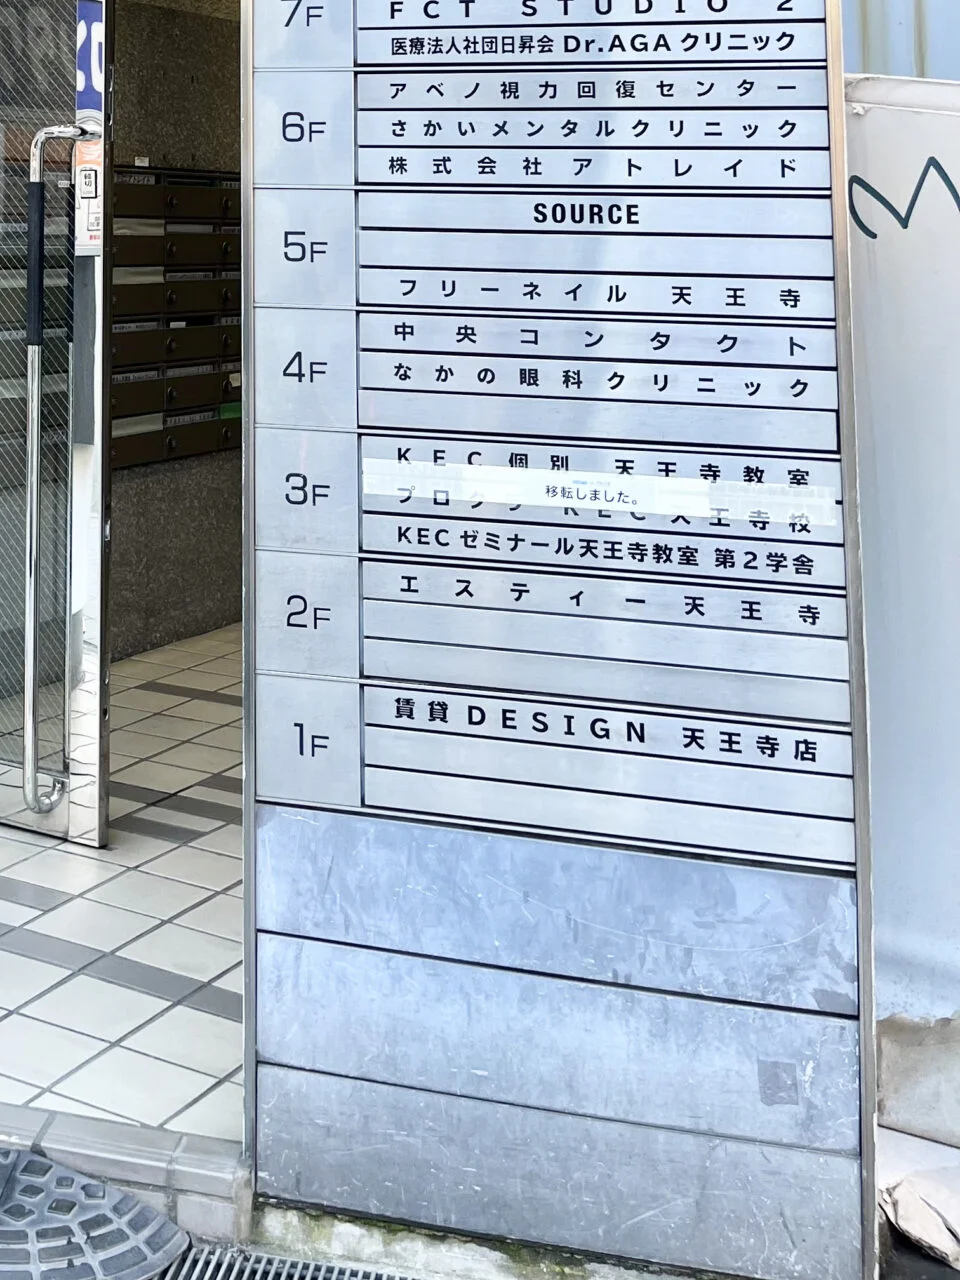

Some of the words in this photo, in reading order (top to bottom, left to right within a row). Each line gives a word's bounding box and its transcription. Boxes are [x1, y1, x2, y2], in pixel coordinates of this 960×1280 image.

[390, 35, 554, 57] 医療法人社団日昇会
[389, 79, 798, 101] アベノ視力回復センター
[282, 111, 326, 144] 6F
[390, 118, 798, 140] さかいメンタルクリニック
[388, 156, 798, 179] 株式会社アトレイド
[533, 203, 640, 225] SOURCE
[283, 230, 328, 263] 5F
[400, 279, 628, 304] フリーネイル
[671, 285, 802, 309] 天王寺
[394, 322, 808, 357] 中央コンタクト
[283, 352, 328, 384] 4F
[393, 363, 810, 400] なかの眼科クリニック
[285, 472, 330, 507] 3F
[544, 483, 639, 507] 移転しました。
[713, 547, 816, 577] 第2学舎
[286, 594, 332, 630] 2F
[400, 575, 822, 627] エスティー天王寺
[294, 723, 330, 758] 1F
[394, 698, 647, 743] 賃貸DESIGN
[682, 726, 819, 763] 天王寺店
